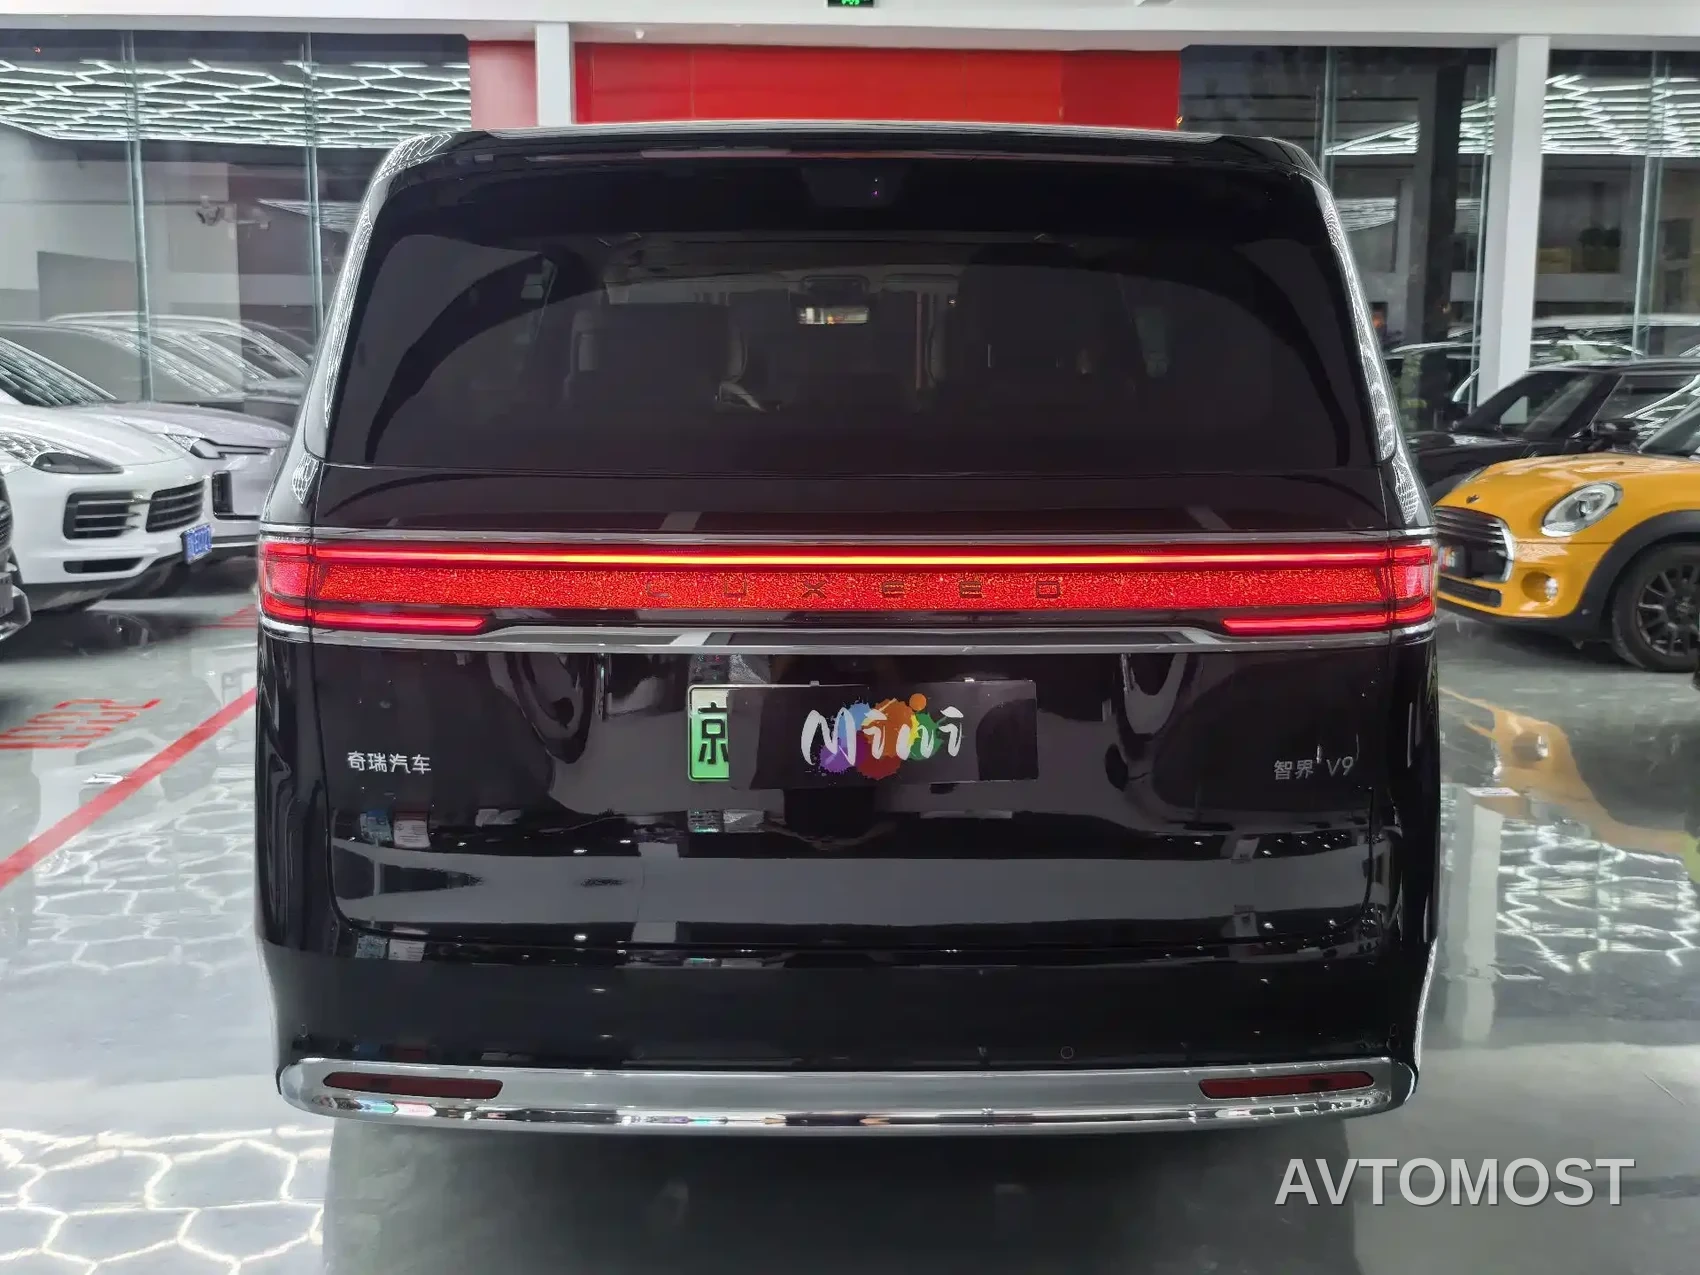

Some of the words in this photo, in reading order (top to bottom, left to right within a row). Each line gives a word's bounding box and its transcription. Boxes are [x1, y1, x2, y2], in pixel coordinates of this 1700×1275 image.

[647, 580, 1061, 599] LUXEED
[697, 701, 729, 765] 京
[801, 705, 964, 767] Mini
[347, 750, 432, 774] 奇瑞汽车
[1273, 759, 1314, 780] 智界
[1326, 756, 1354, 776] V9
